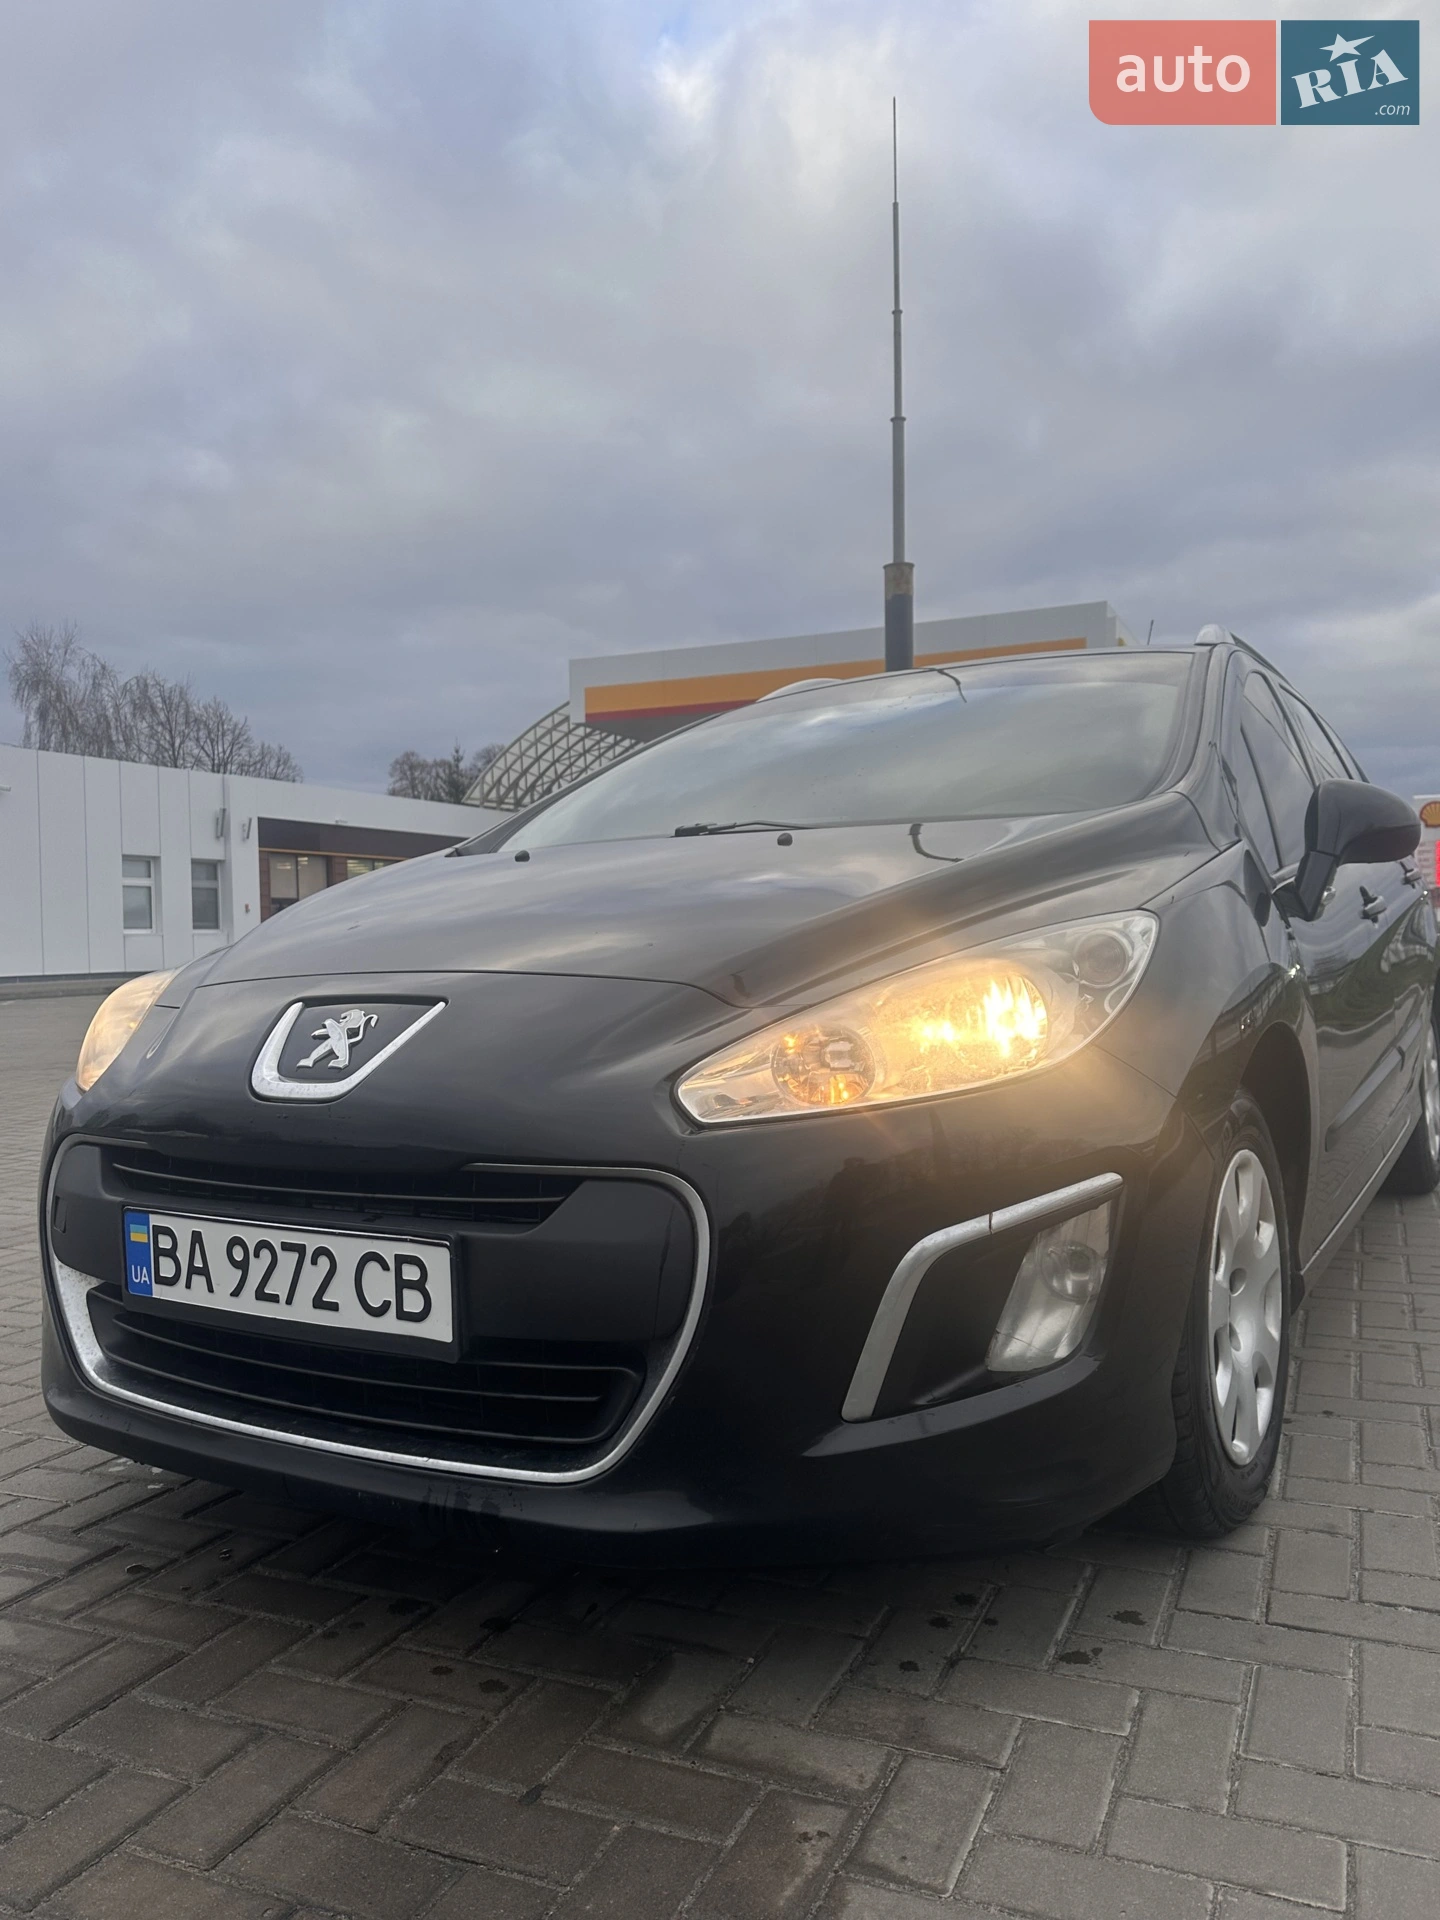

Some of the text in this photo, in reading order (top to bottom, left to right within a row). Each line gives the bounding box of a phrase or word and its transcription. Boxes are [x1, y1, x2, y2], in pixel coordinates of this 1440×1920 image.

[131, 1264, 150, 1285] UA
[152, 1224, 432, 1323] BA 9272 CB
